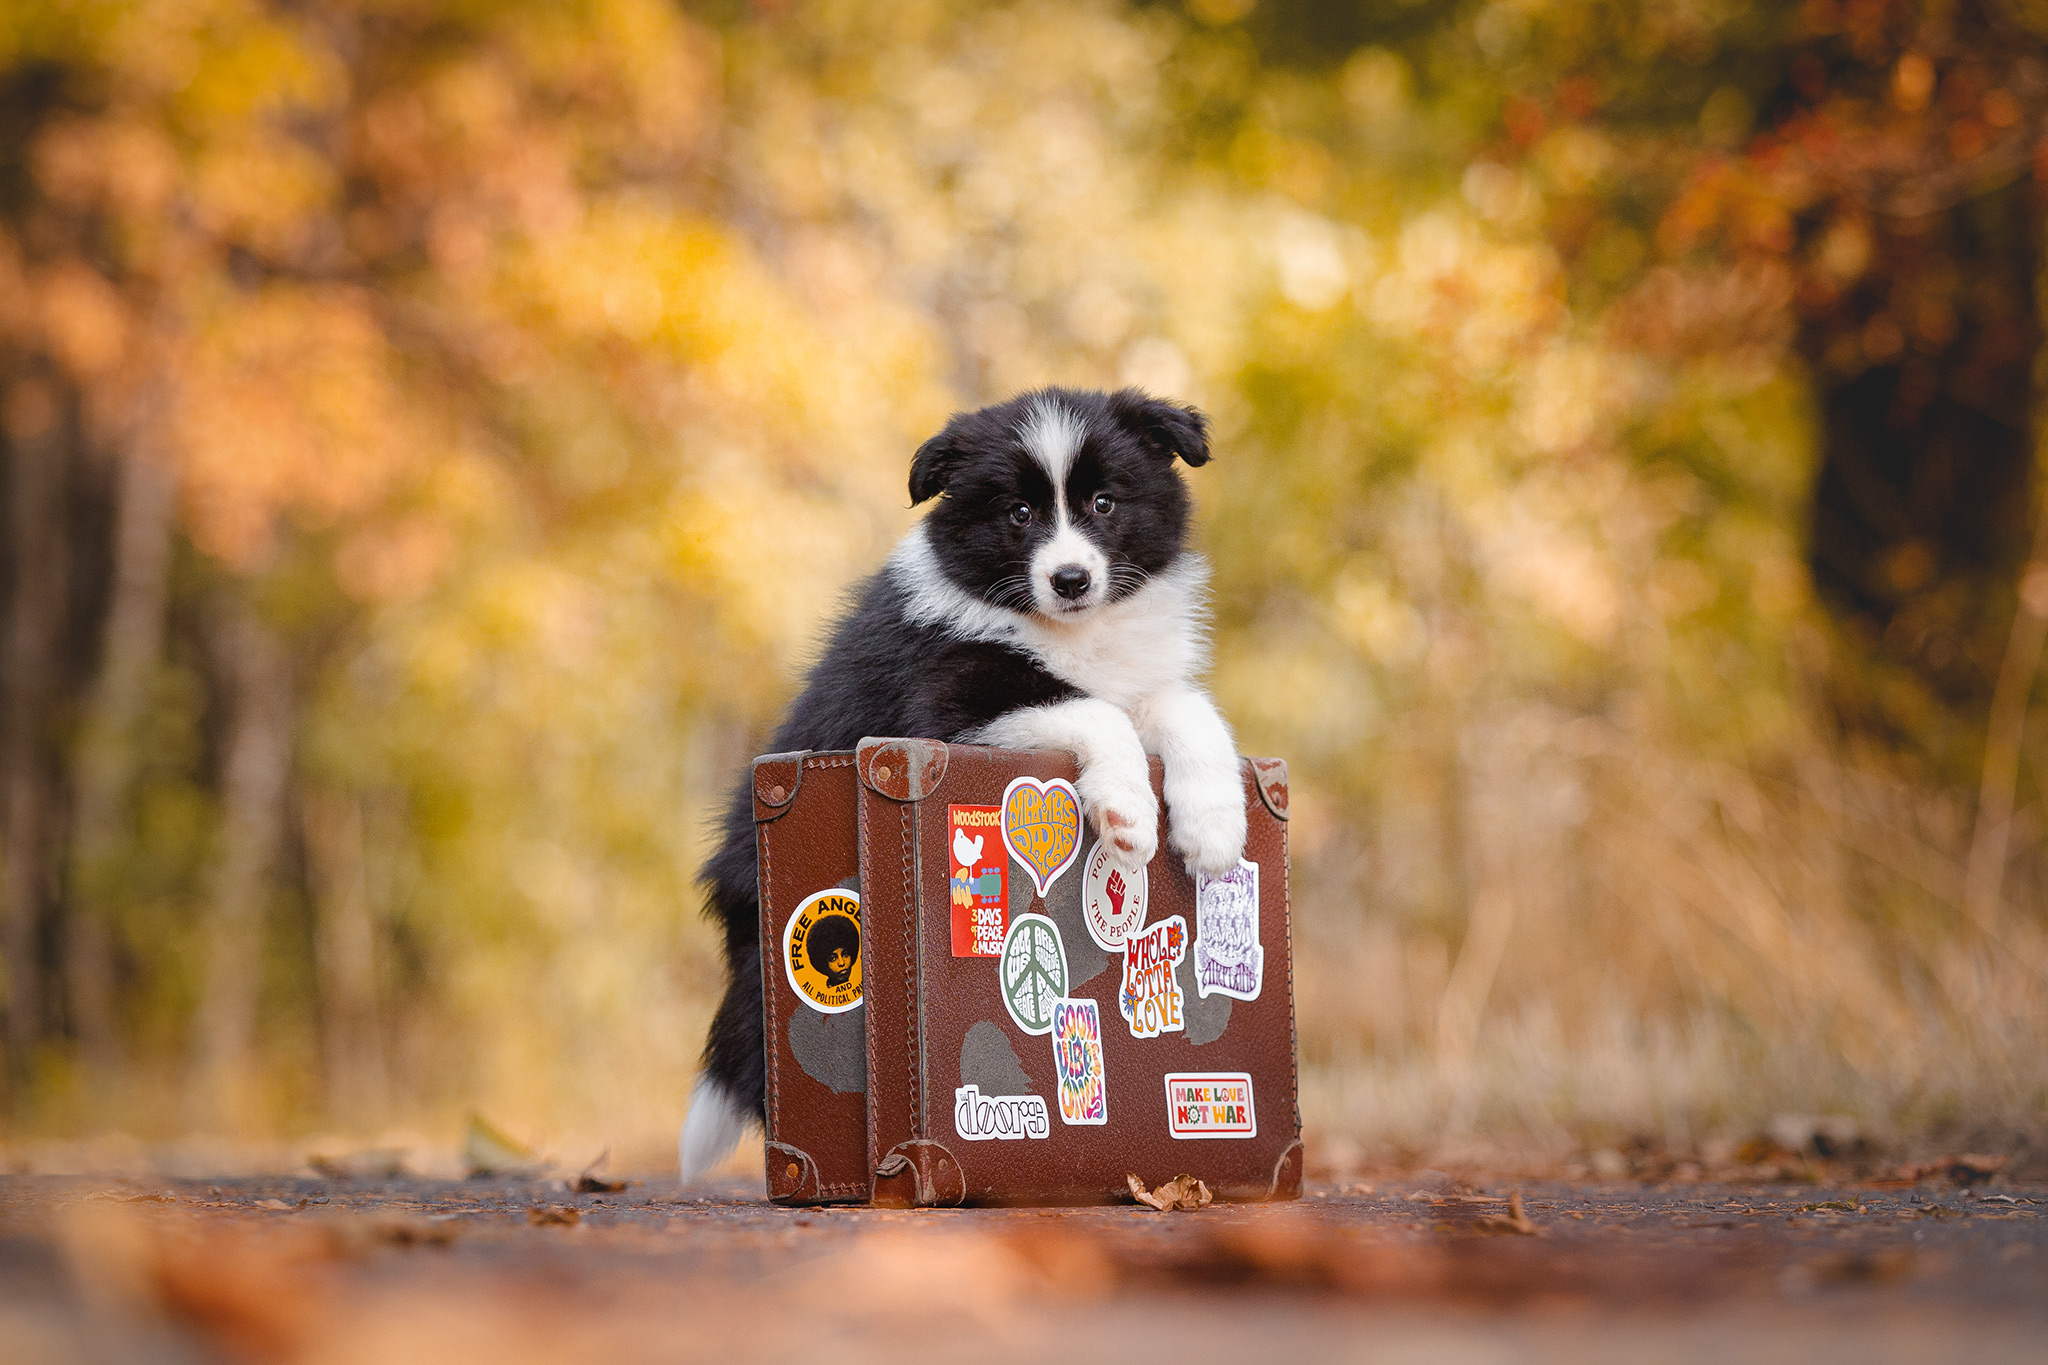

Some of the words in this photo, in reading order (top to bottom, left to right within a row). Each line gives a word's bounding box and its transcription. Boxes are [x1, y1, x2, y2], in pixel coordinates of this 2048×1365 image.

[971, 909, 978, 922] 3
[977, 908, 1002, 926] DAYS
[977, 925, 1004, 941] PEACE
[1091, 899, 1108, 932] THE
[1109, 895, 1140, 938] PEOPLE
[791, 913, 812, 971] FREE
[971, 940, 979, 954] &
[1010, 926, 1032, 957] ALL
[1034, 925, 1057, 954] ARE
[1127, 926, 1179, 969] WHOLE
[1007, 953, 1031, 988] WE
[1126, 960, 1174, 1001] LOTTA
[801, 981, 814, 996] ALL
[815, 991, 851, 1005] POLITICAL
[835, 982, 852, 993] AND
[1054, 1003, 1098, 1041] GOOD
[1133, 992, 1180, 1032] LOVE
[1057, 1036, 1101, 1080] VIBES
[1061, 1075, 1104, 1120] ONLY
[1175, 1087, 1212, 1102] MAKE
[1213, 1087, 1245, 1102] LOVE
[1177, 1104, 1209, 1125] NOT
[1212, 1105, 1247, 1124] WAR
